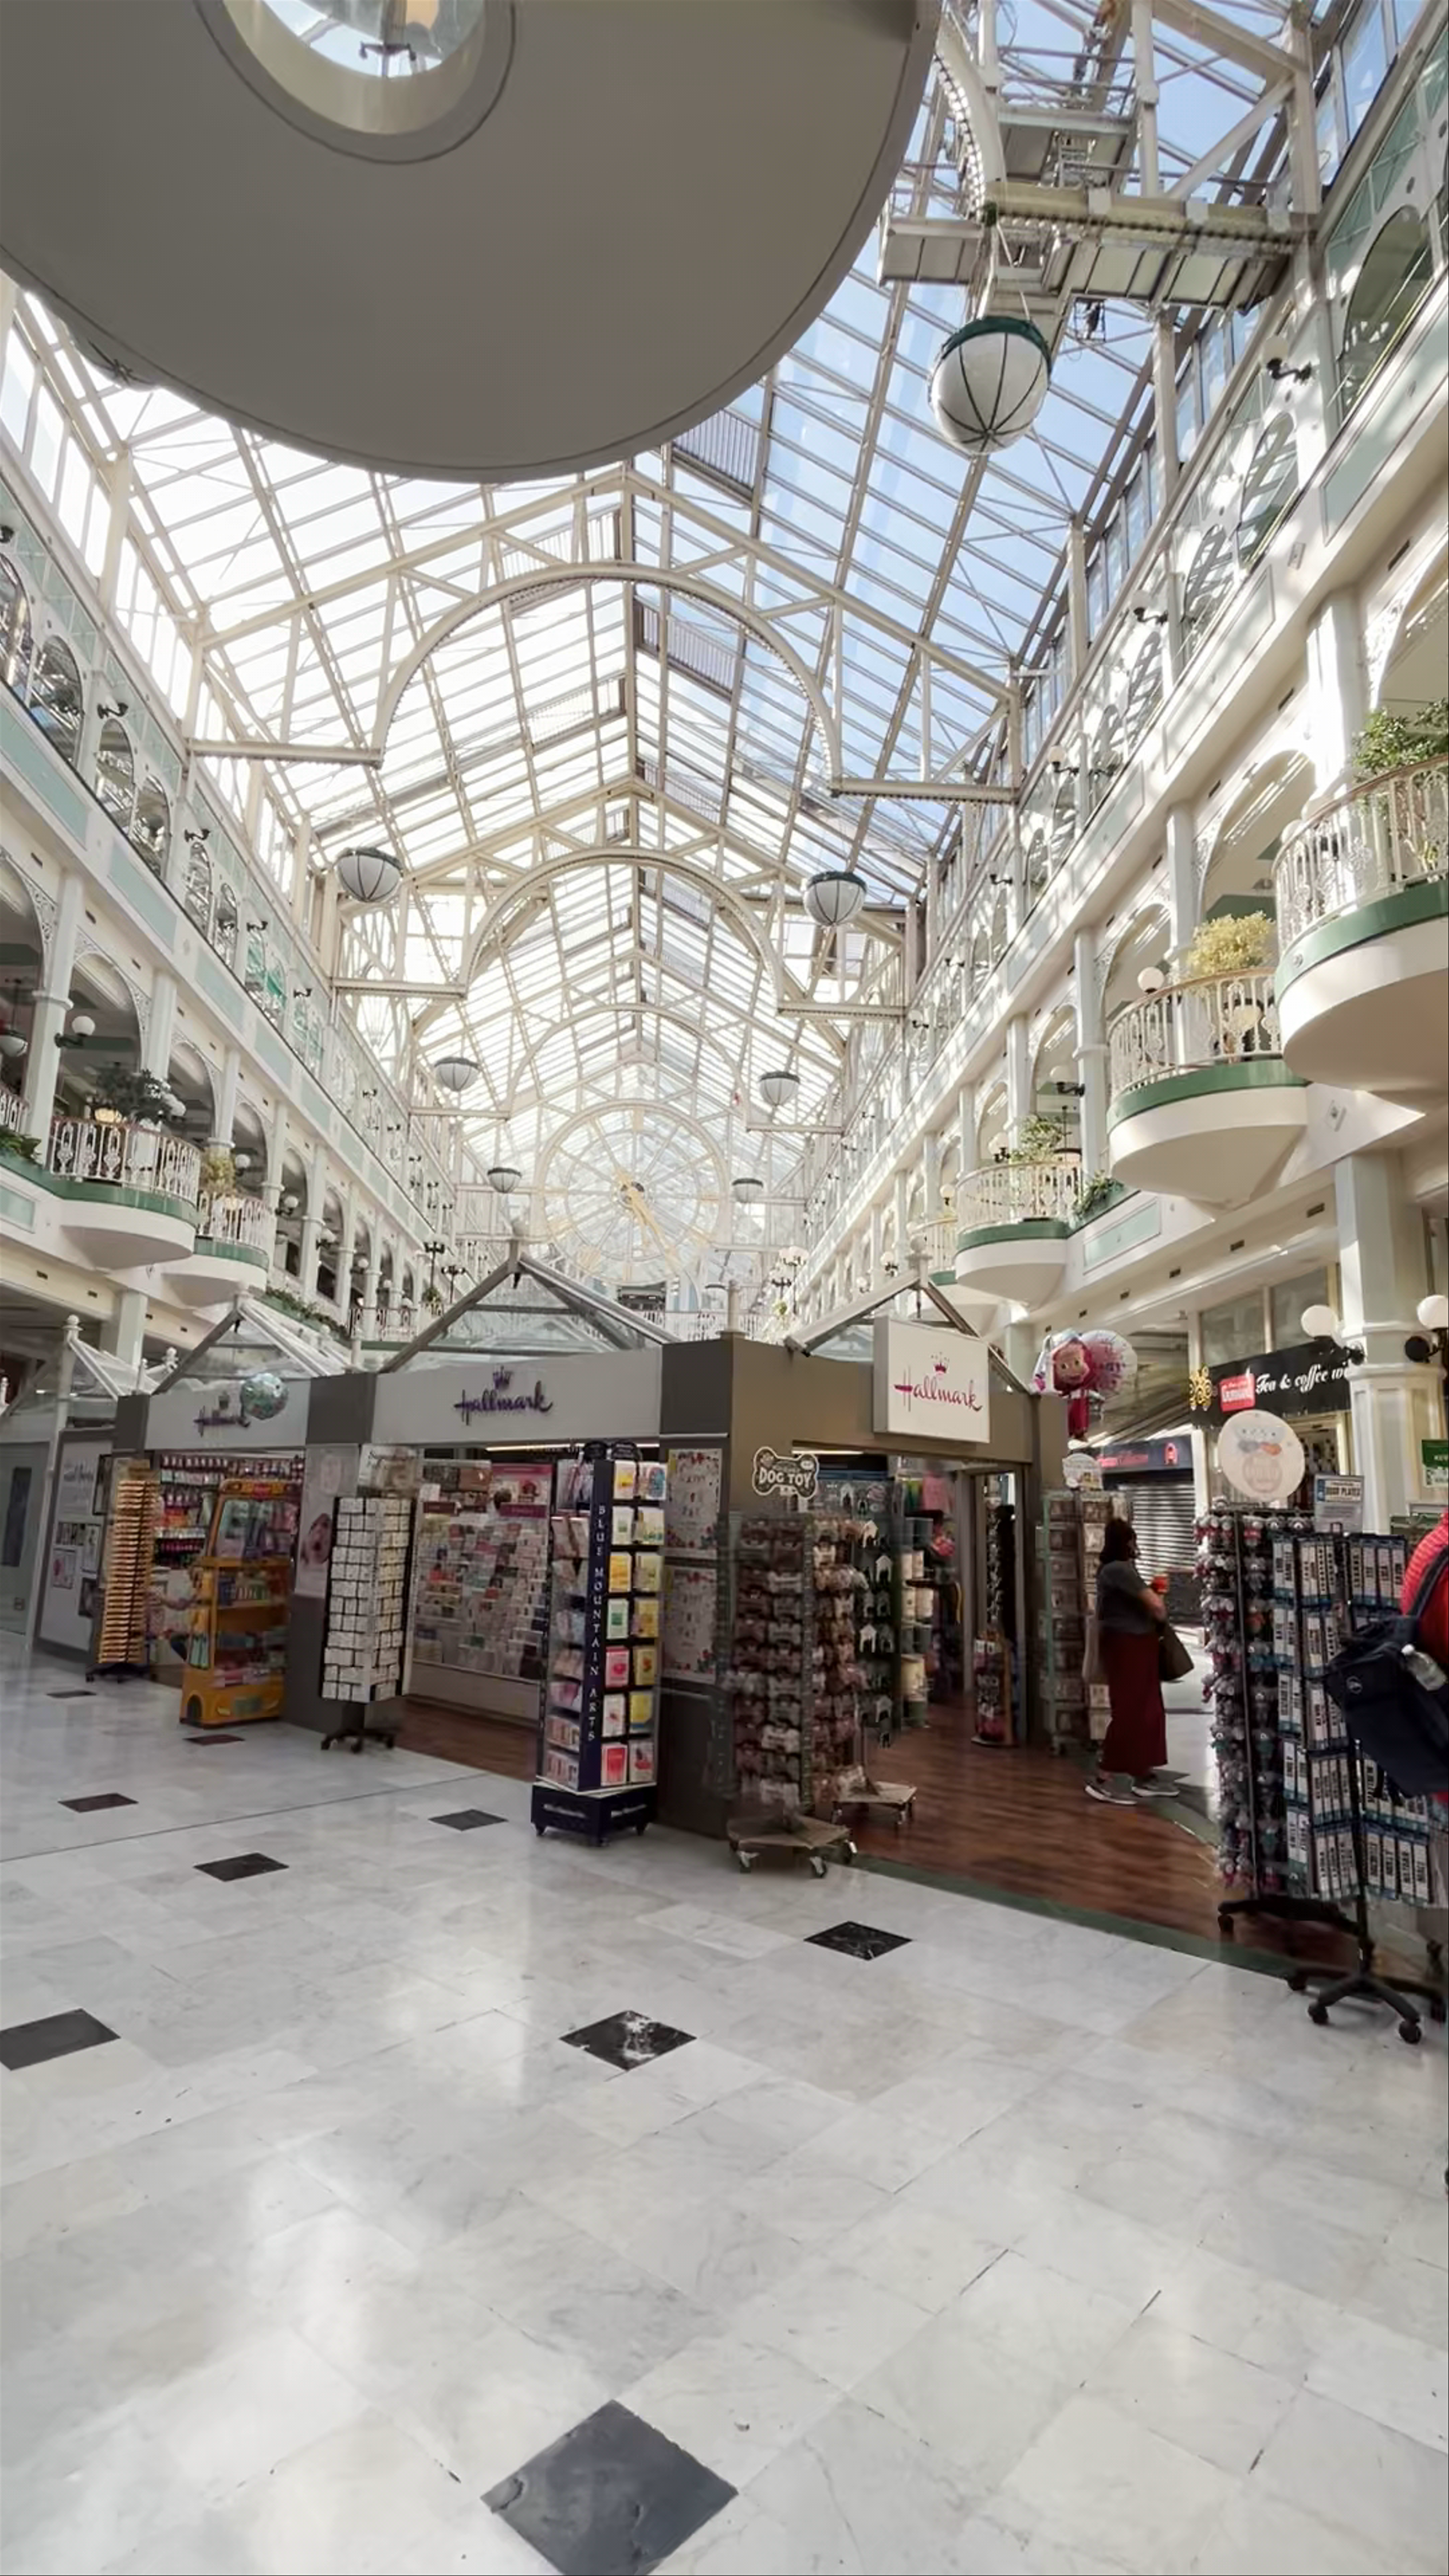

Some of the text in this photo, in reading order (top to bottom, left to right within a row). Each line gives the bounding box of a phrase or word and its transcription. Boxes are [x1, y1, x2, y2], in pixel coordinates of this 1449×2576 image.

[893, 1364, 983, 1413] Hallmark
[1255, 1373, 1276, 1395] Tea
[1279, 1373, 1292, 1390] &
[1294, 1364, 1328, 1393] coffee
[453, 1380, 554, 1426] Hallmark
[758, 1467, 812, 1490] DOG TOY
[587, 1505, 607, 1741] BLUE MOUNTAIN ARTS
